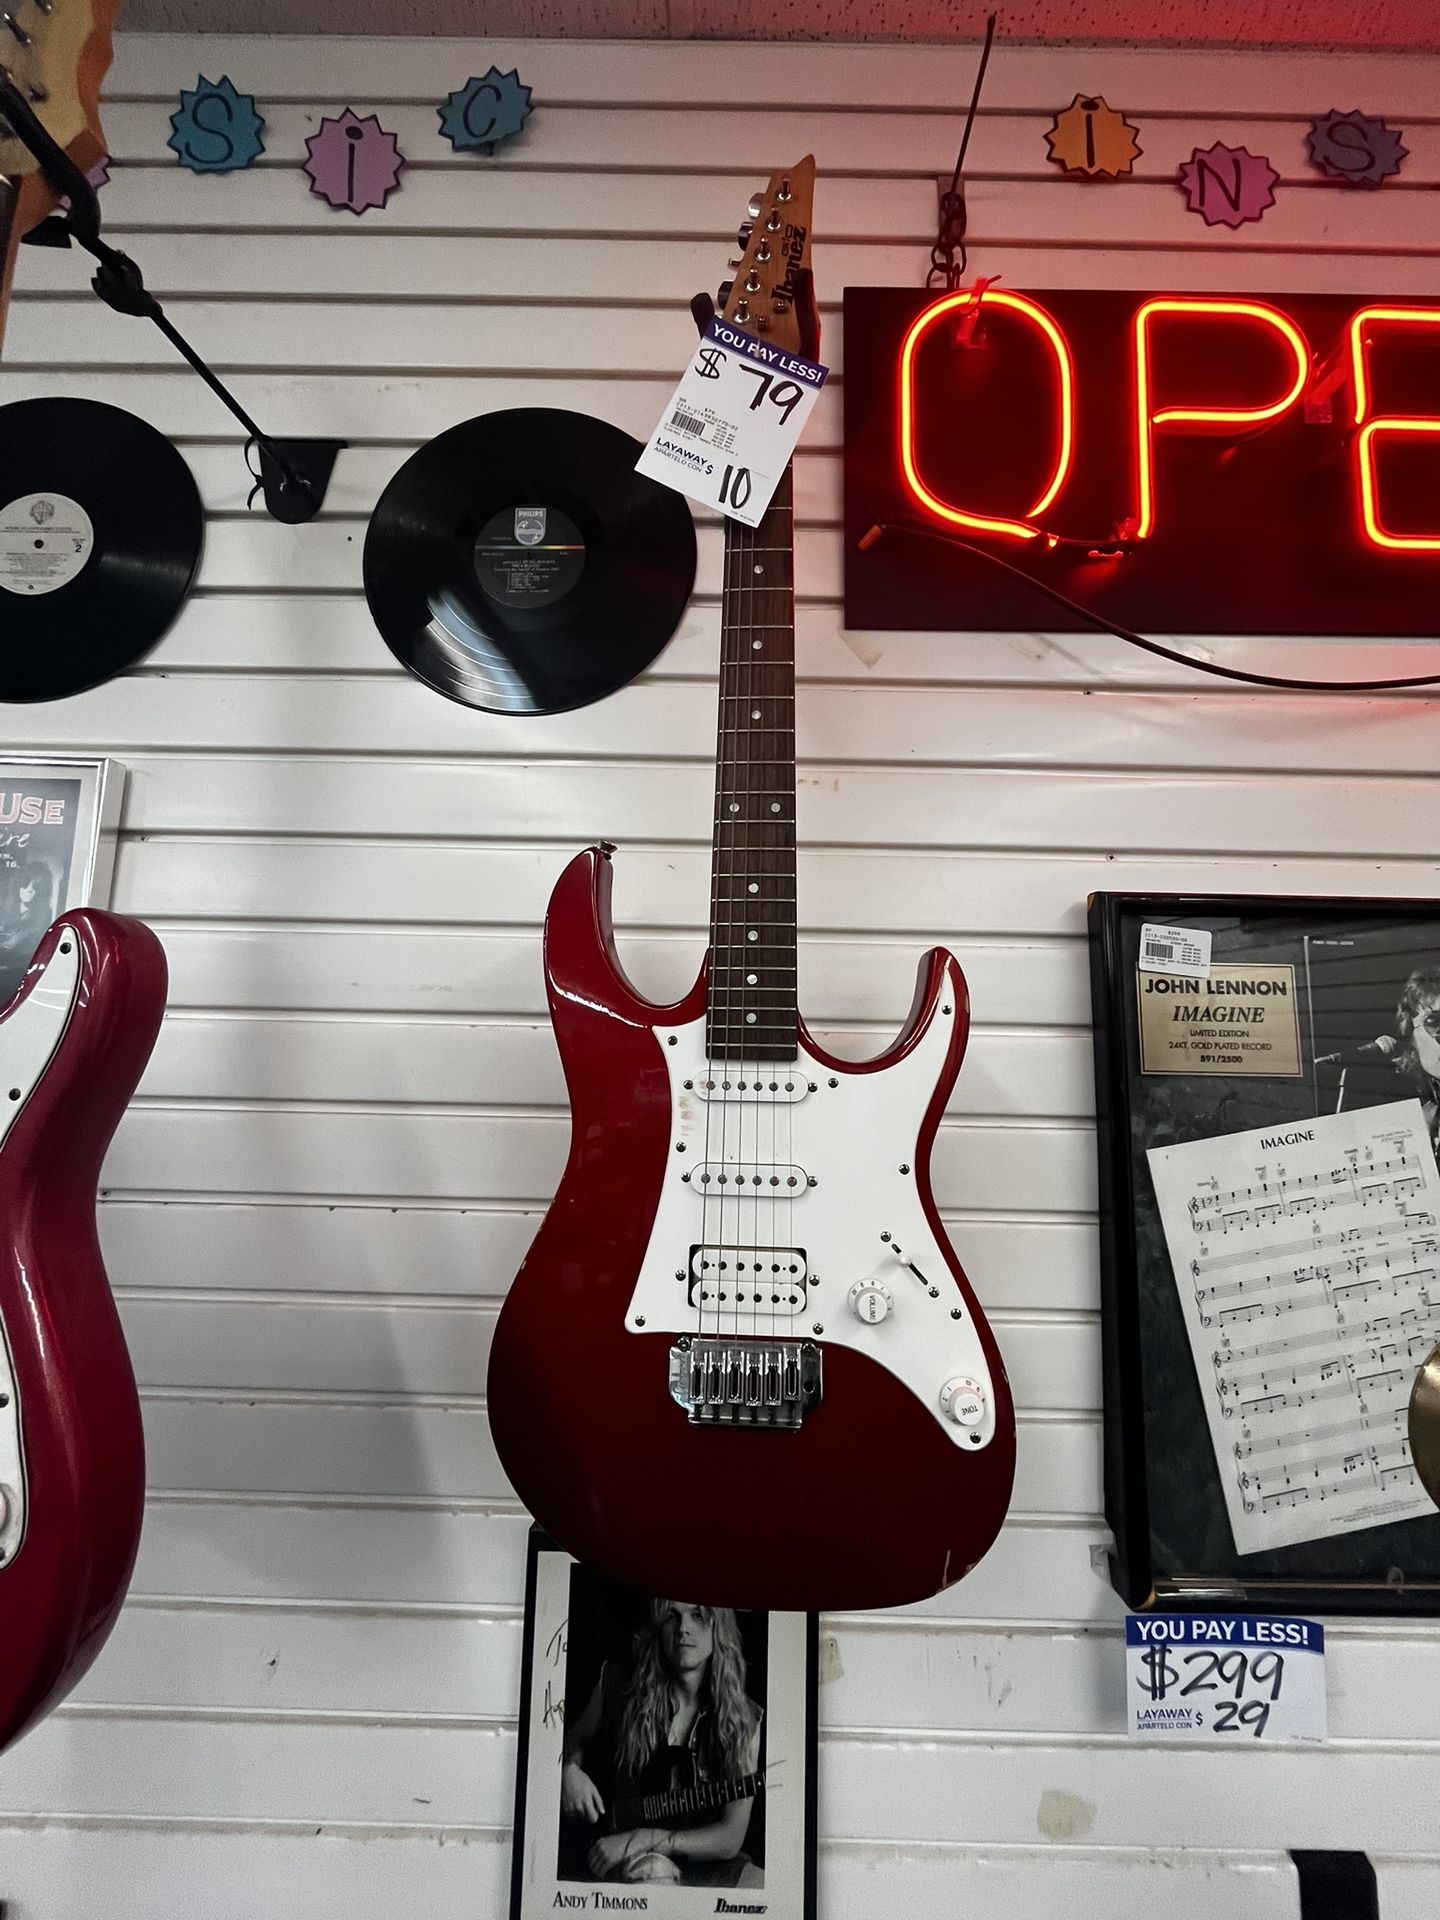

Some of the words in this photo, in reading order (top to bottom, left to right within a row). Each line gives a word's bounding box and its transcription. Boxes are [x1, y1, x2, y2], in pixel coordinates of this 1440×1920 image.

[712, 323, 746, 348] YOU
[747, 342, 779, 363] PAY
[779, 354, 822, 383] LESS!
[739, 363, 804, 426] 79
[656, 437, 708, 466] LAYAWAY
[687, 460, 703, 473] CON
[718, 464, 752, 509] 10
[518, 510, 544, 518] PHILIPS
[75, 544, 82, 553] 2
[1145, 978, 1200, 994] JOHN
[1206, 979, 1287, 996] LENNON
[1172, 1005, 1265, 1023] IMAGINE
[1190, 1029, 1217, 1037] LIMITED
[1219, 1029, 1250, 1038] EDITION
[1191, 1041, 1213, 1050] GOLD
[1214, 1042, 1240, 1050] PLATED
[1241, 1043, 1272, 1051] RECORD
[1260, 1130, 1315, 1150] IMAGINE
[961, 1404, 979, 1416] TONE
[1136, 1621, 1185, 1641] YOU
[1192, 1621, 1236, 1641] PAY
[1243, 1621, 1309, 1645] LESS!
[1136, 1708, 1193, 1720] LAYAWAY
[1212, 1700, 1271, 1738] 29
[1175, 1721, 1193, 1729] CON
[552, 1891, 588, 1909] ANDY
[592, 1892, 649, 1911] TIMMONS
